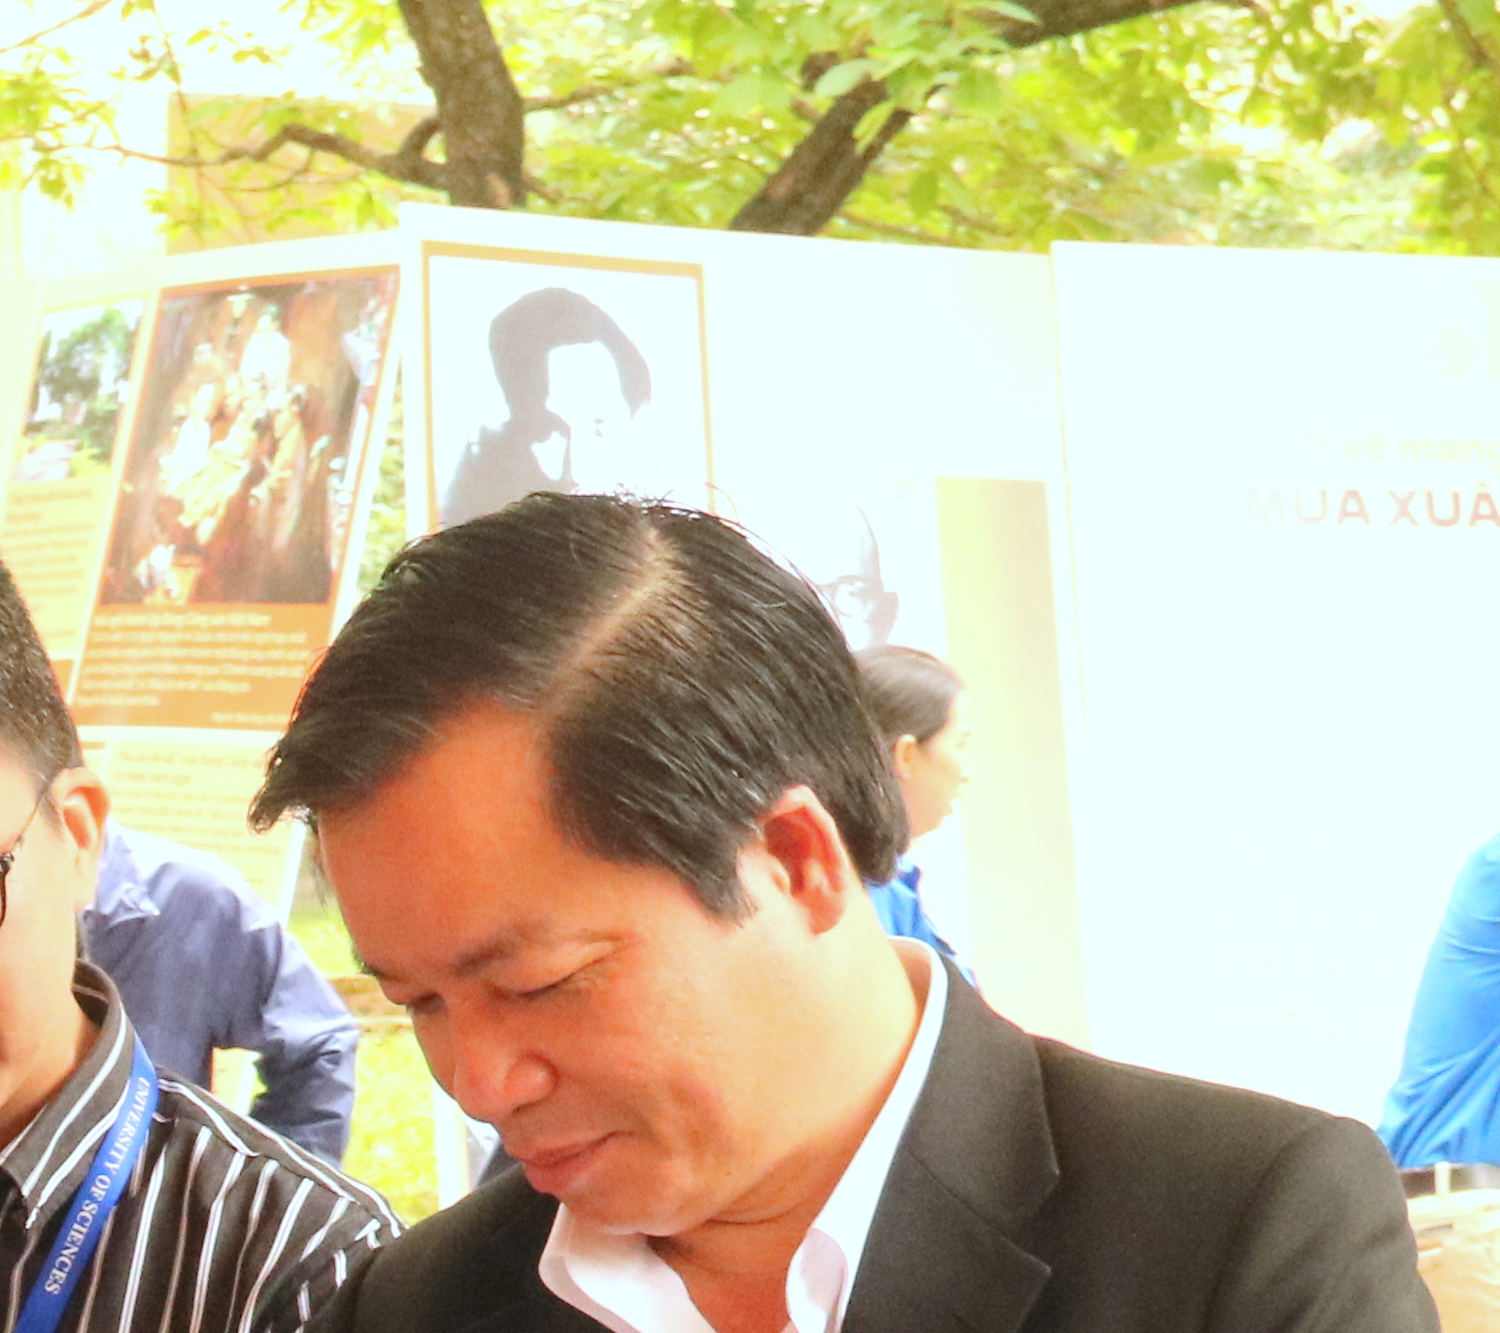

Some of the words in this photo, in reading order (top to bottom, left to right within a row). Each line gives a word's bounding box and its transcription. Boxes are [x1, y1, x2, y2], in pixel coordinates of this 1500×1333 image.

[103, 1077, 152, 1175] UNIVERSITY
[91, 1174, 113, 1200] OF
[43, 1200, 98, 1295] SCIENCES
